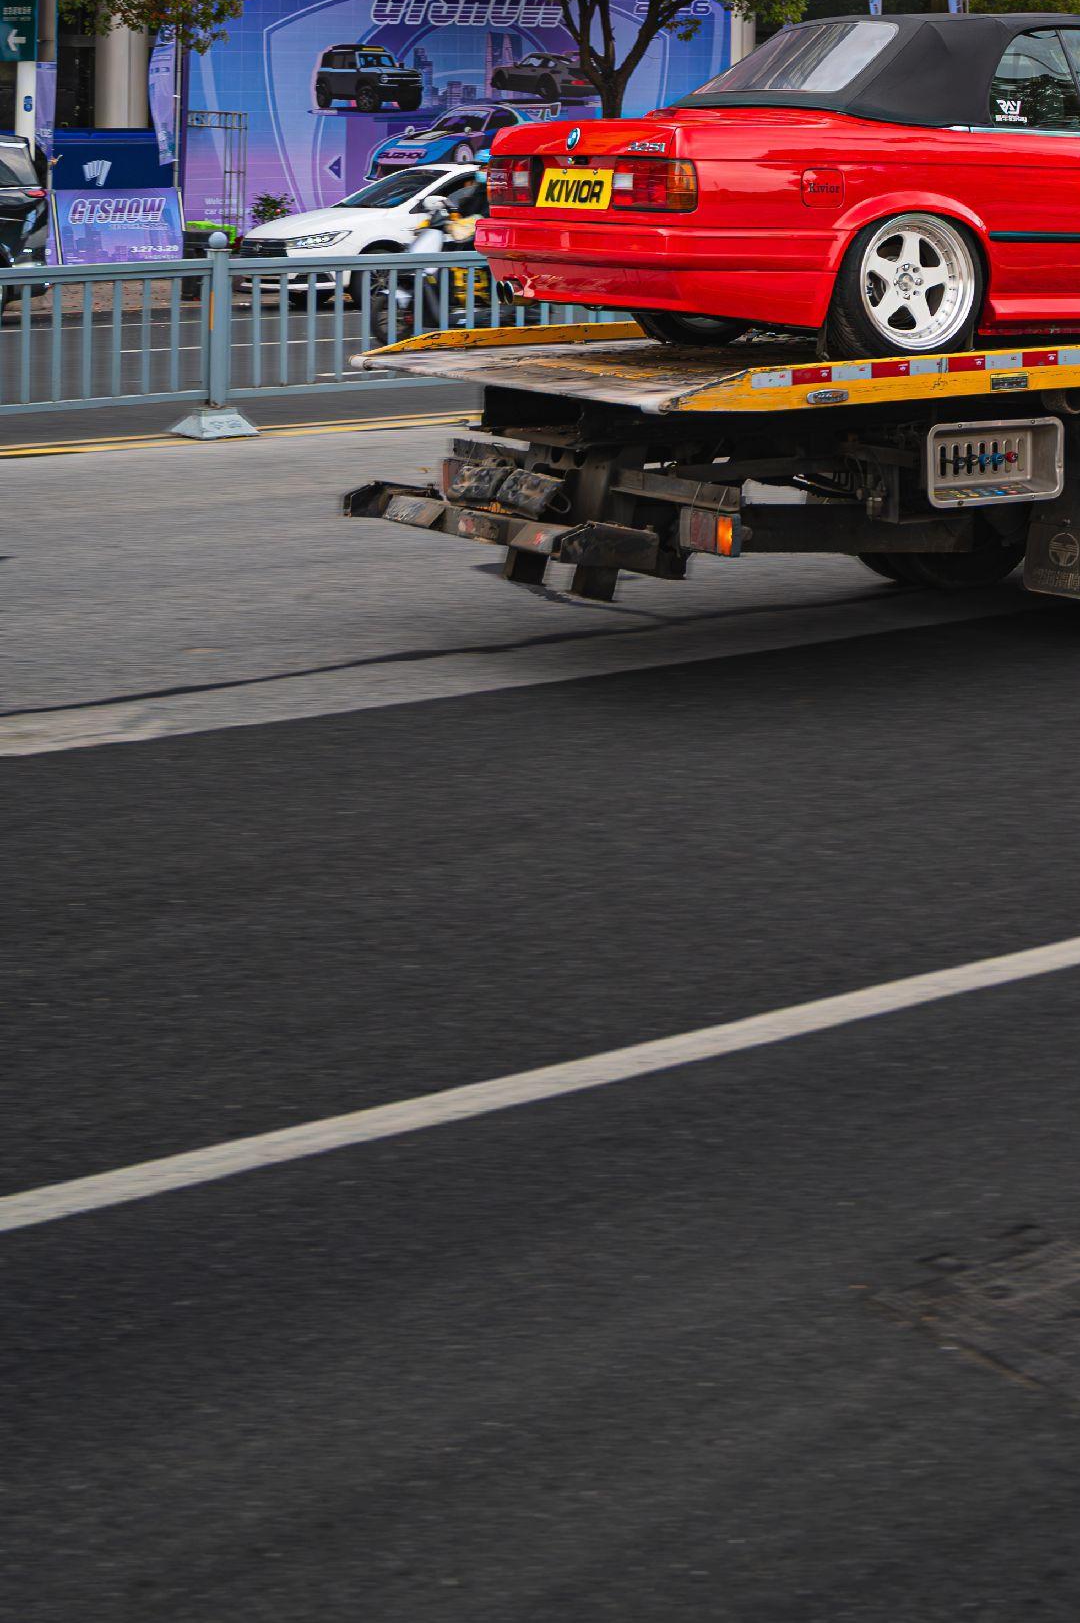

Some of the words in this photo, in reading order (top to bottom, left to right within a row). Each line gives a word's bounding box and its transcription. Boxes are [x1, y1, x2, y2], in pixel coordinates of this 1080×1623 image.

[544, 180, 605, 203] KIVIOR
[808, 182, 840, 194] Kivior
[67, 197, 167, 225] GTSHOW
